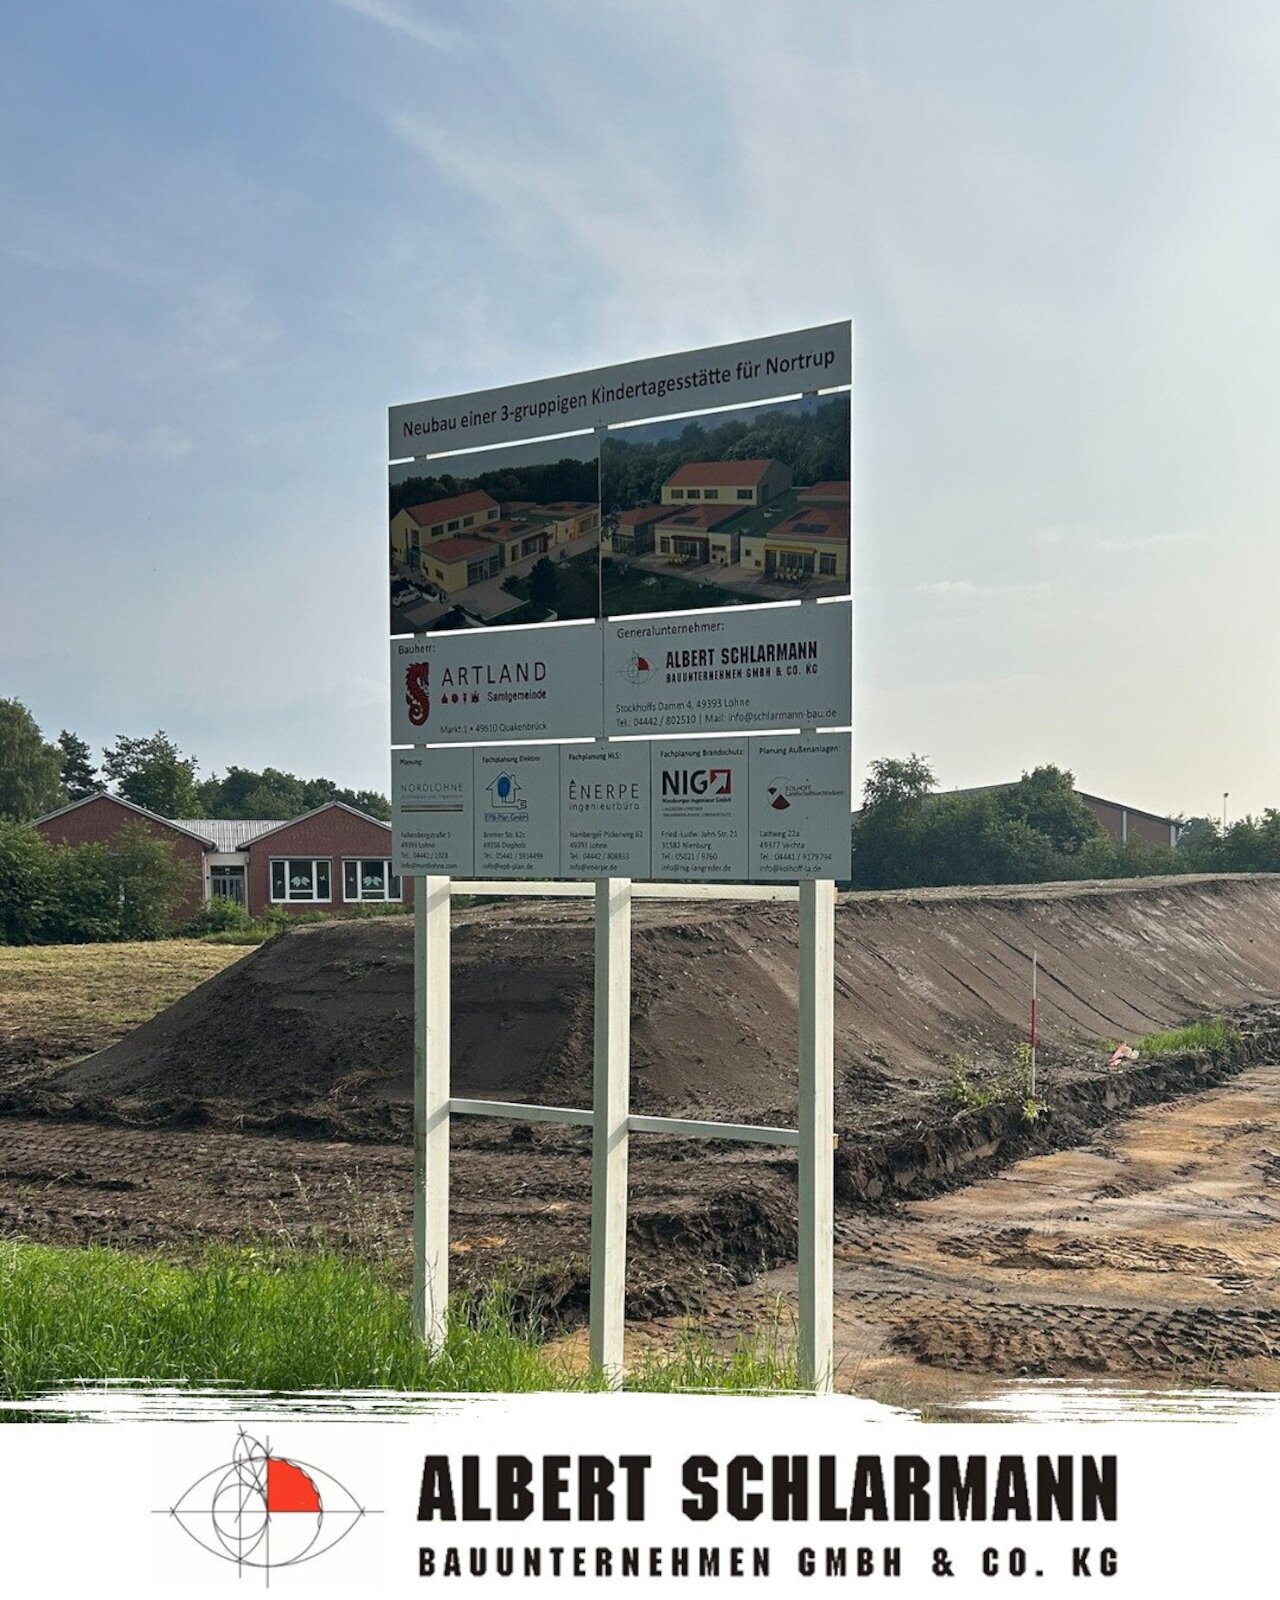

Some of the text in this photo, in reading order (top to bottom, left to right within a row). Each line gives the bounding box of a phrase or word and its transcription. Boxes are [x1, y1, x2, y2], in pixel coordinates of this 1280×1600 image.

[403, 347, 835, 438] Neubau einer 3-gruppigen Kindertagesstätte für Nortrup
[617, 621, 724, 639] Generalunternehmer:
[399, 645, 435, 655] Bauherr:
[666, 641, 817, 668] ALBERT SCHLARMANN
[442, 661, 547, 687] ARTLAND
[667, 664, 818, 683] BAUUNTERNEHMEN GMBH & CO. KG
[487, 690, 547, 703] Samtgemeinde
[616, 698, 750, 713] Stockhoffs Damm 4, 49393 Lohne
[633, 716, 657, 726] 04442
[666, 715, 696, 725] 802510
[705, 714, 726, 724] Mail:
[728, 708, 837, 722] info@schlarmann-bau.de
[440, 725, 461, 734] Markt
[476, 723, 497, 732] 49610
[499, 722, 547, 733] Quakenbrück
[568, 753, 606, 762] Fachplanung
[660, 750, 701, 758] Fachplanung
[760, 747, 787, 755] Planung
[401, 783, 463, 792] NORDLOHNE
[662, 770, 708, 795] NIG
[682, 842, 712, 850] Nienburg
